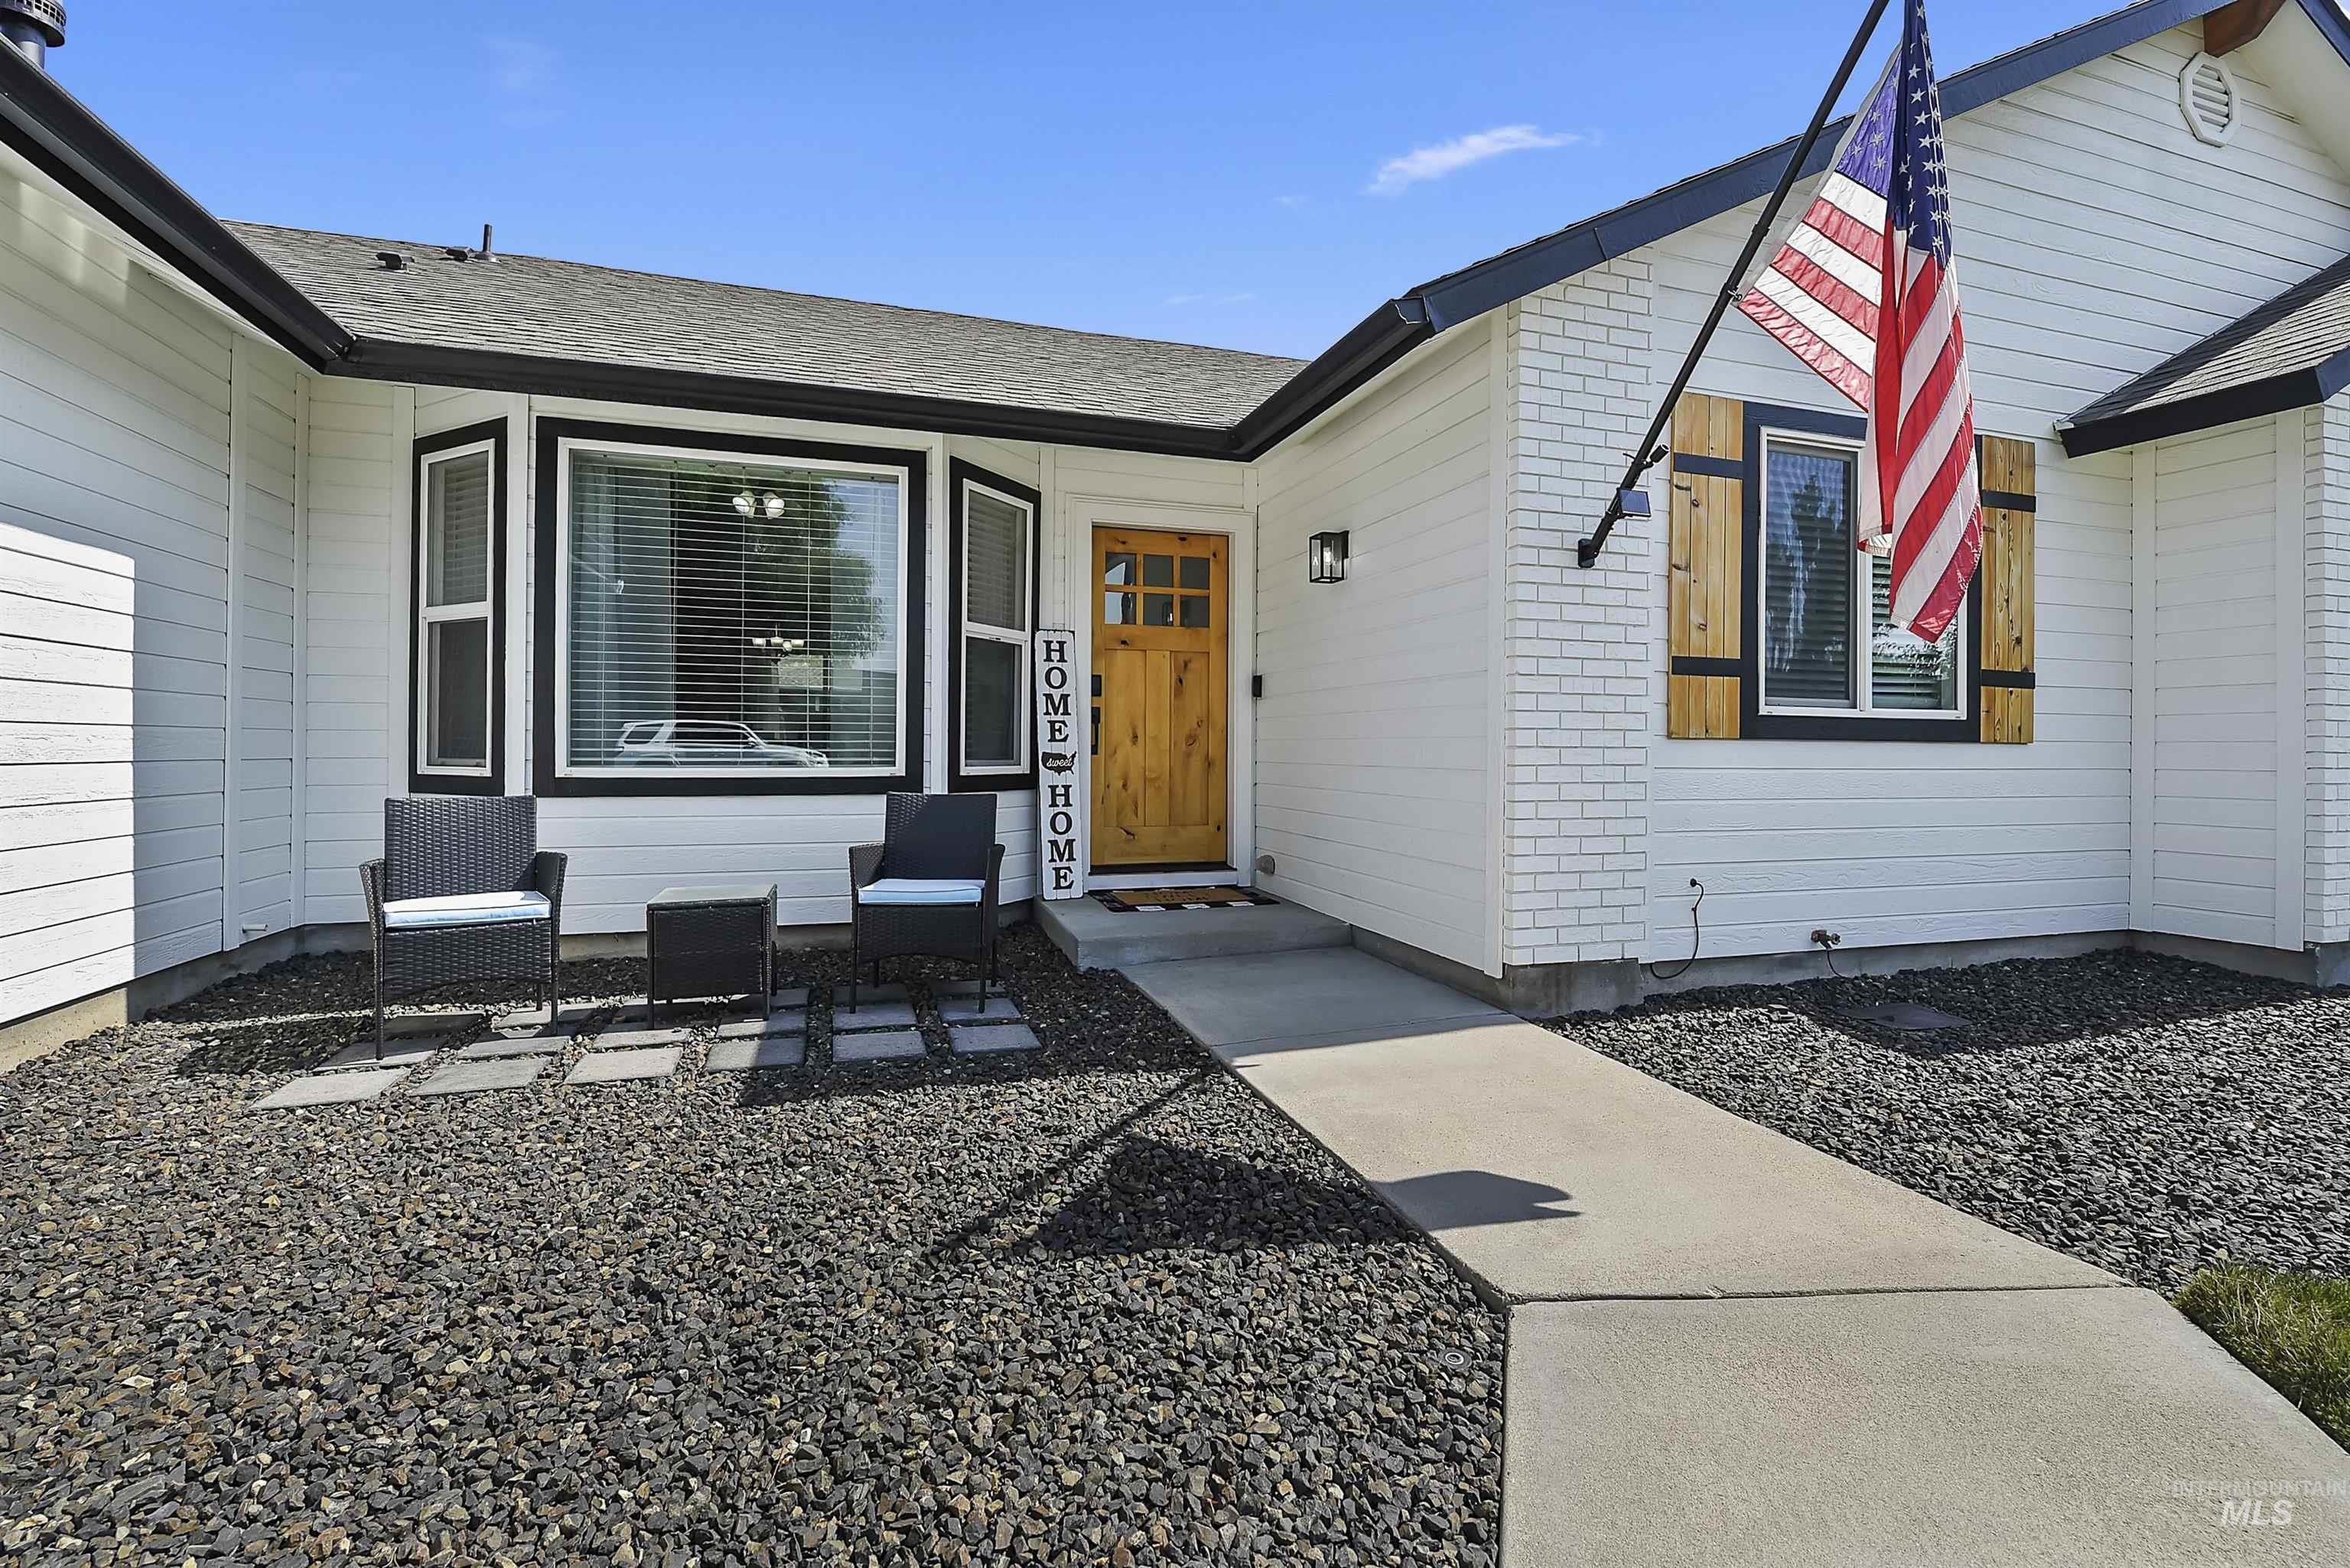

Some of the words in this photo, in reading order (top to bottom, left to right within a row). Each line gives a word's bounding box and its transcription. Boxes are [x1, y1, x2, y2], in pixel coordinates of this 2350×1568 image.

[1042, 639, 1072, 743] HOME
[1046, 756, 1073, 767] sweet
[1047, 784, 1077, 890] HOME
